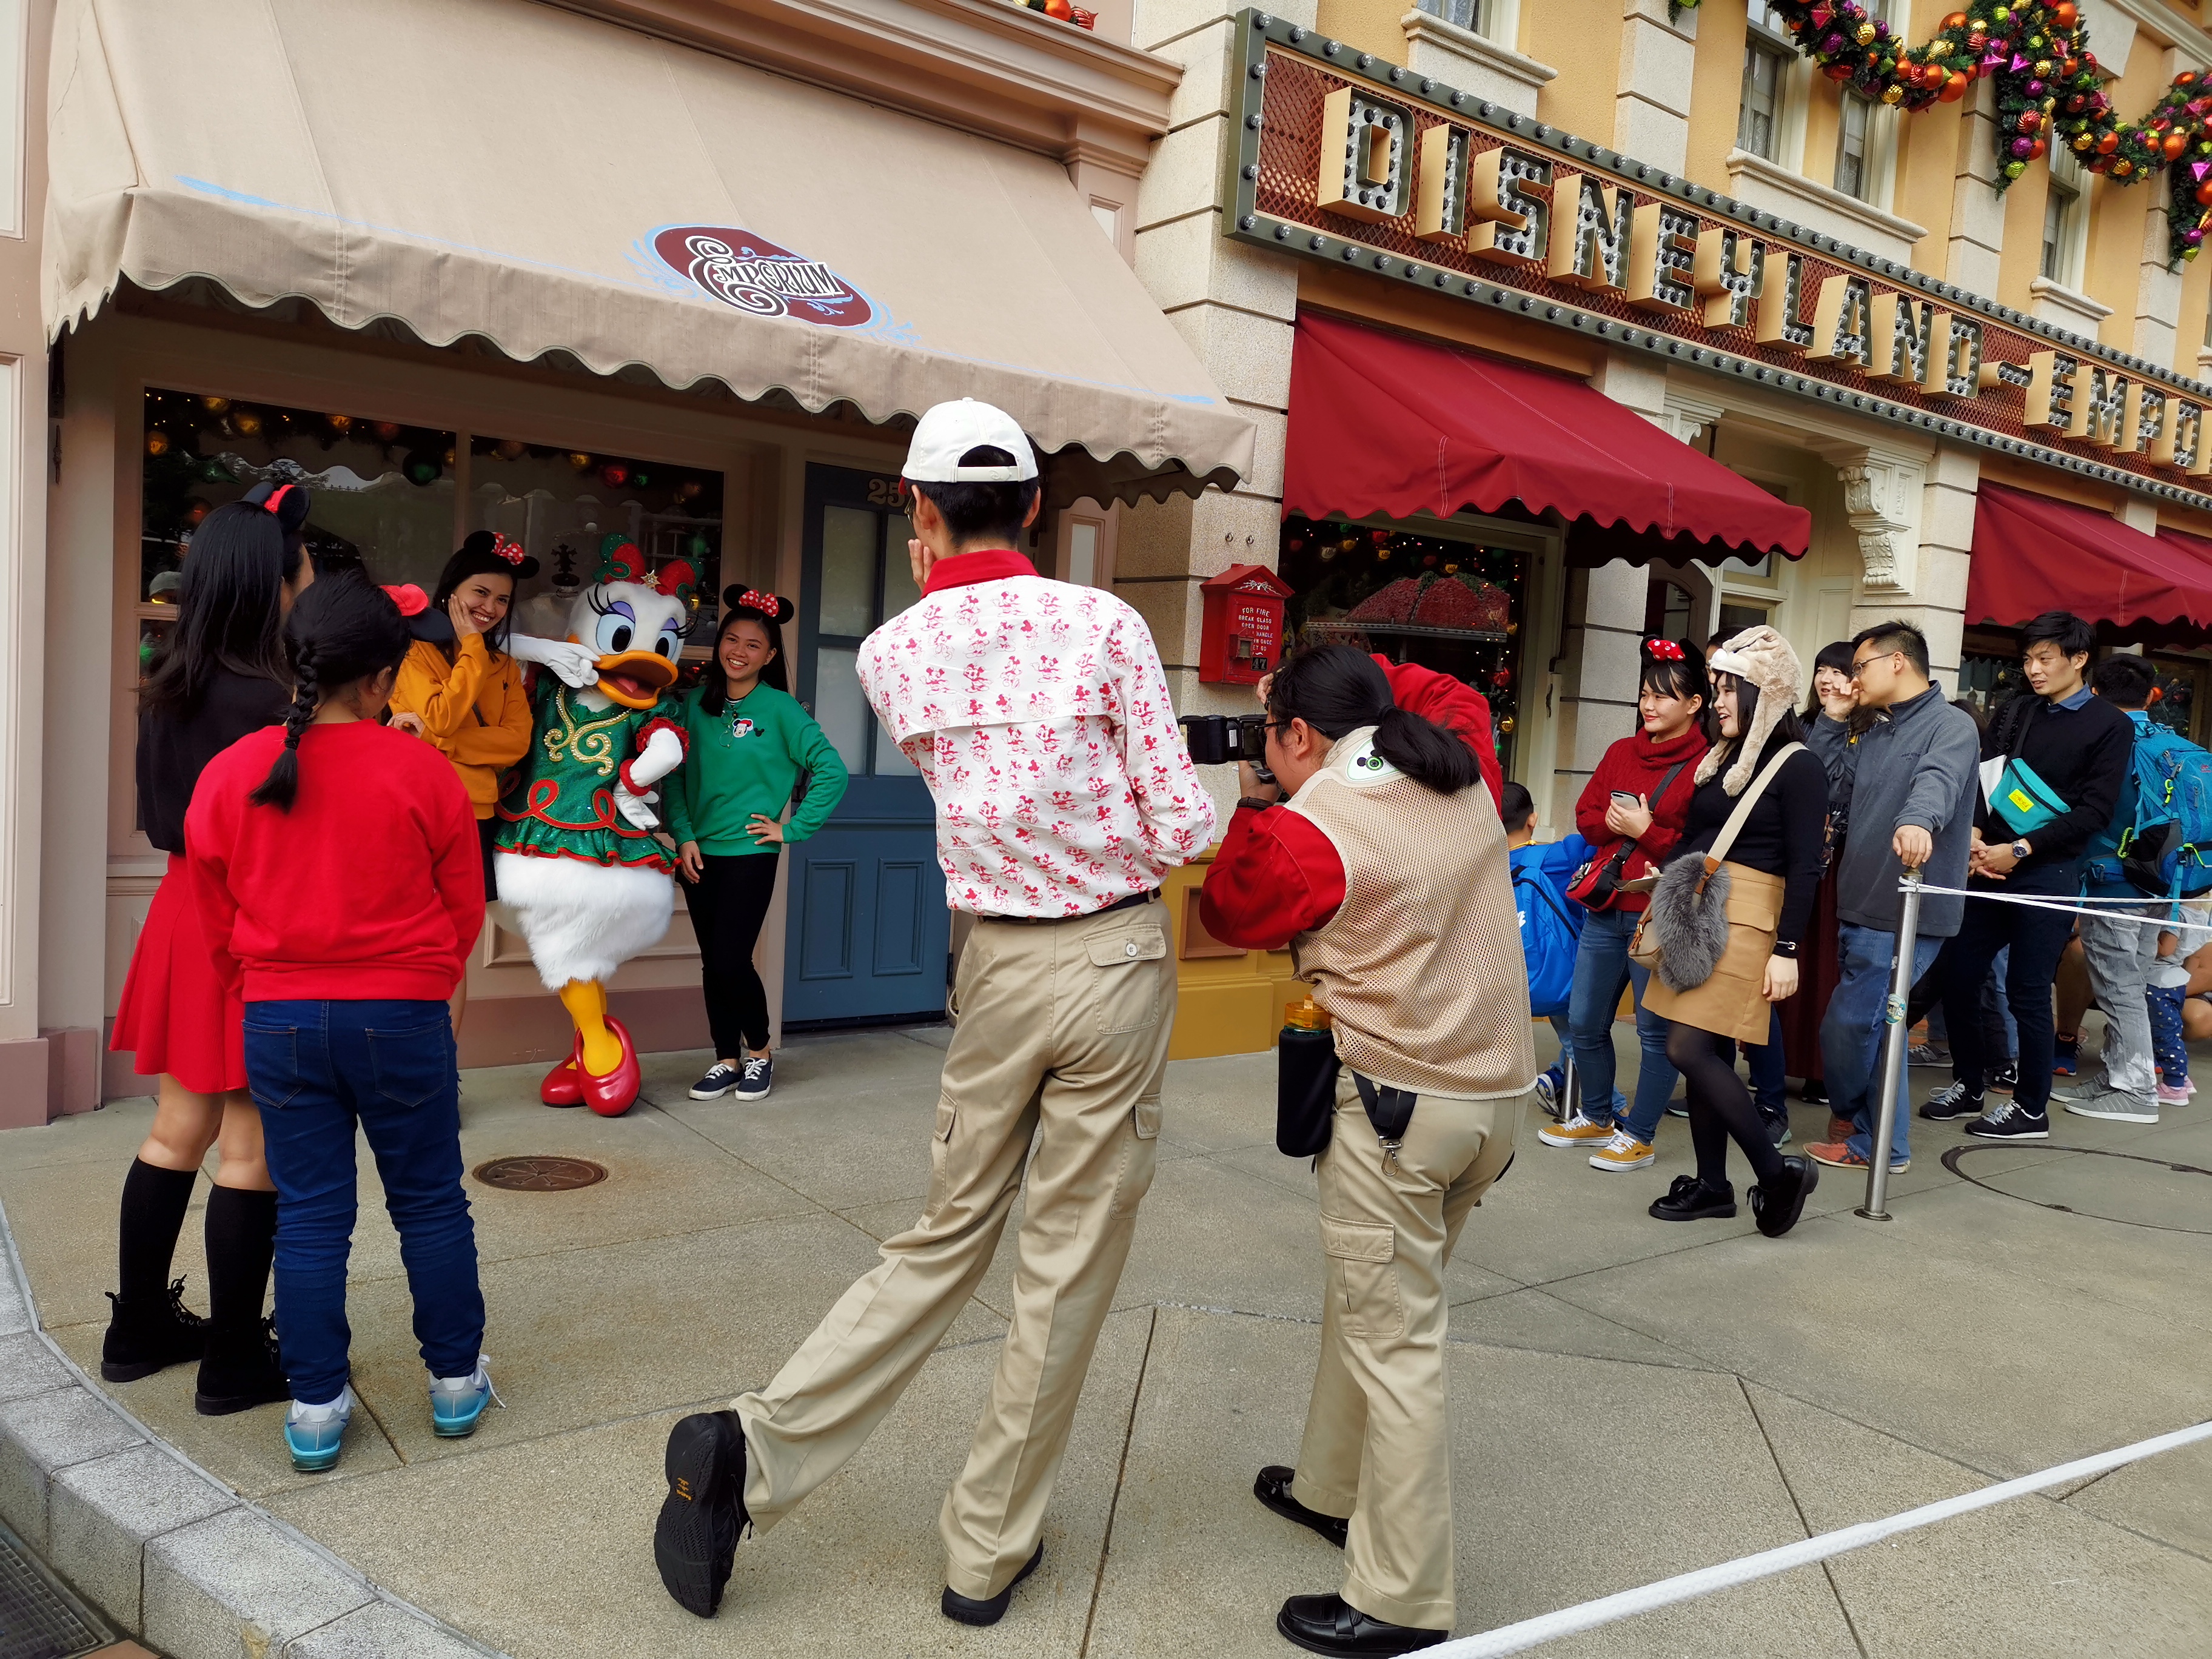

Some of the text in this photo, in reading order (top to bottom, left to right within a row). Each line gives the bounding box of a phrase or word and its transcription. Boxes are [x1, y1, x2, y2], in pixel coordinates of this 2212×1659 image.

[1318, 86, 1983, 399] DISNEYLAND
[2023, 350, 2212, 480] EMPO
[1256, 608, 1270, 617] FIRE
[1253, 658, 1267, 669] 47
